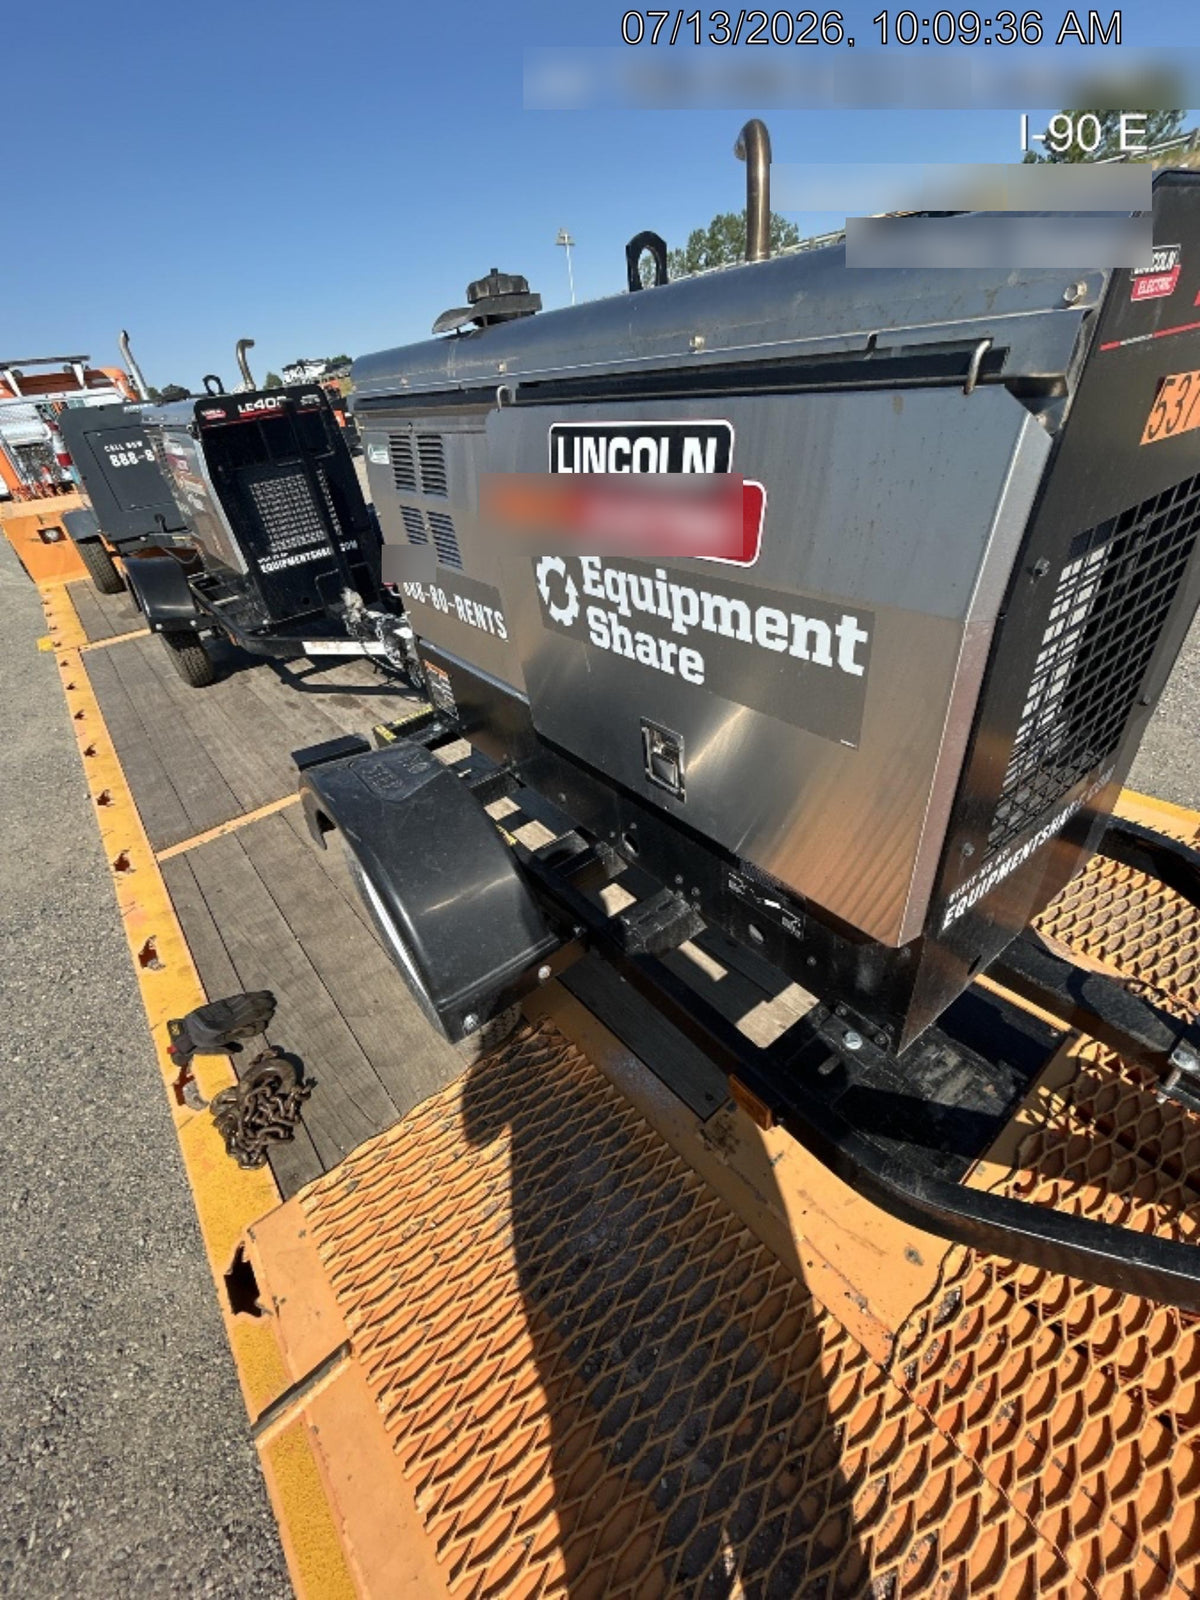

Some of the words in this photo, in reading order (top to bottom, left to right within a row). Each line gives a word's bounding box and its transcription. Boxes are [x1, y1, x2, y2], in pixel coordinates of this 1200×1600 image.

[557, 436, 718, 473] LINCOLN
[580, 556, 869, 676] Equipment
[586, 605, 704, 685] Share
